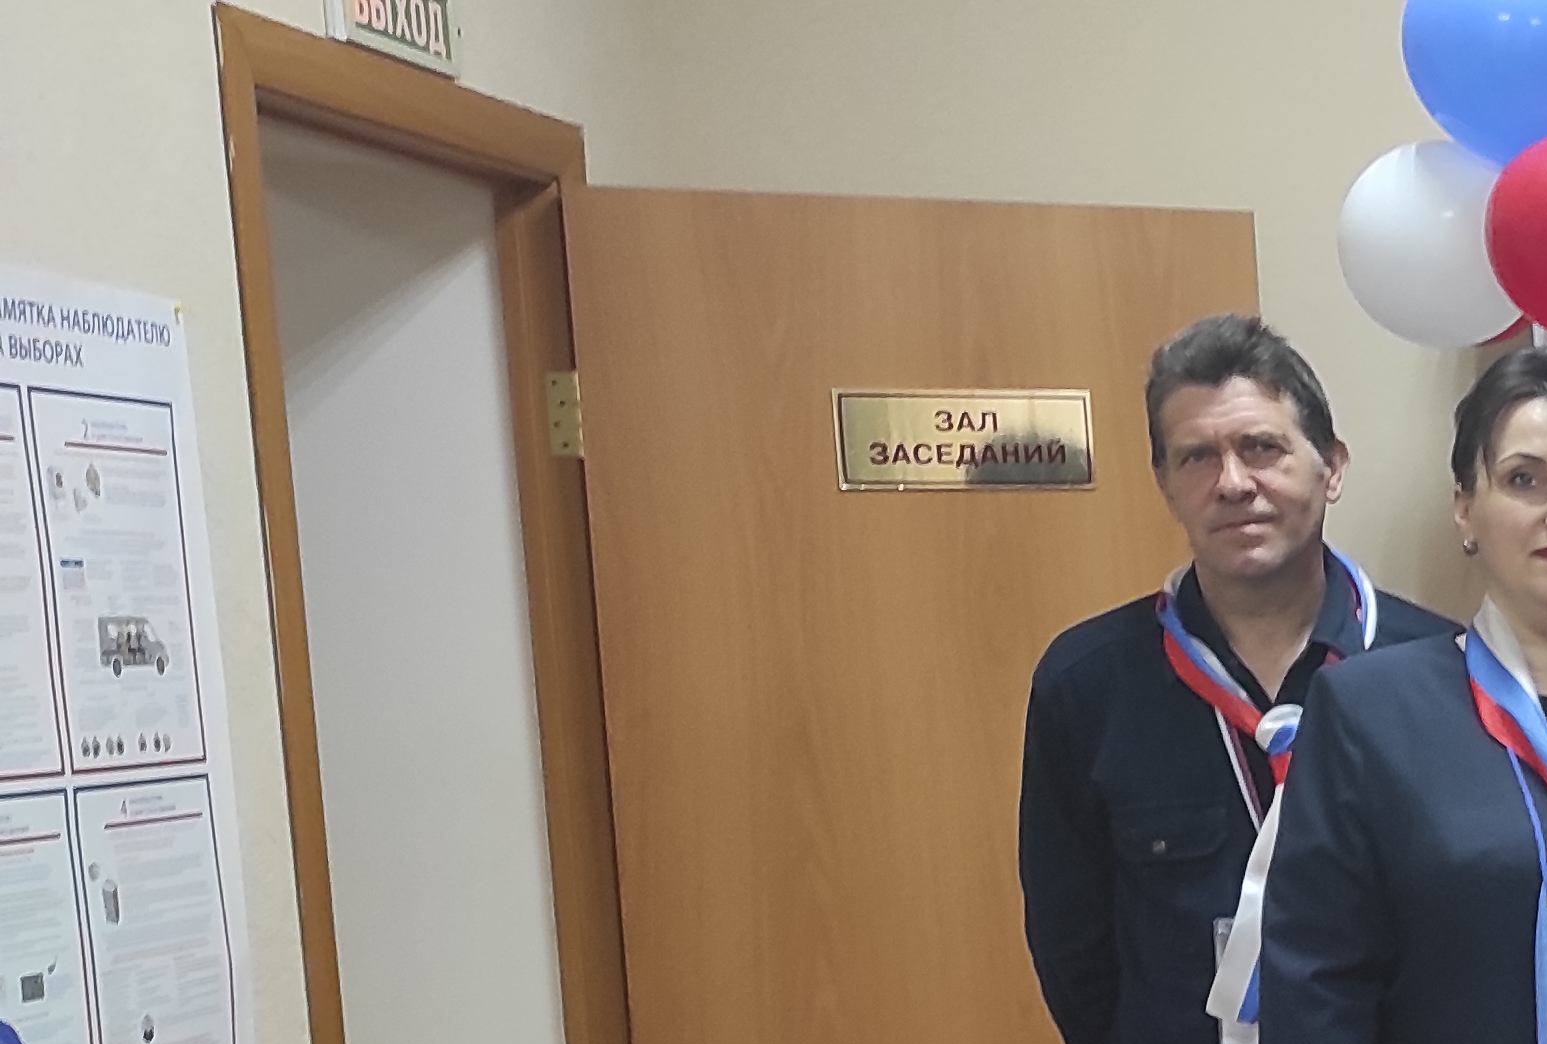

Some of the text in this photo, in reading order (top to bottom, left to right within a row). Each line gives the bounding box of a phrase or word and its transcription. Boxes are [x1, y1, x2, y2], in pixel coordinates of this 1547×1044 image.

[0, 297, 172, 347] МЯТКА НАБЛЮДАТЕЛЮ
[8, 333, 85, 368] ВЫБОРАХ
[934, 410, 998, 433] ЗАЛ
[868, 437, 1067, 469] ЗАСЕДАНИЙ
